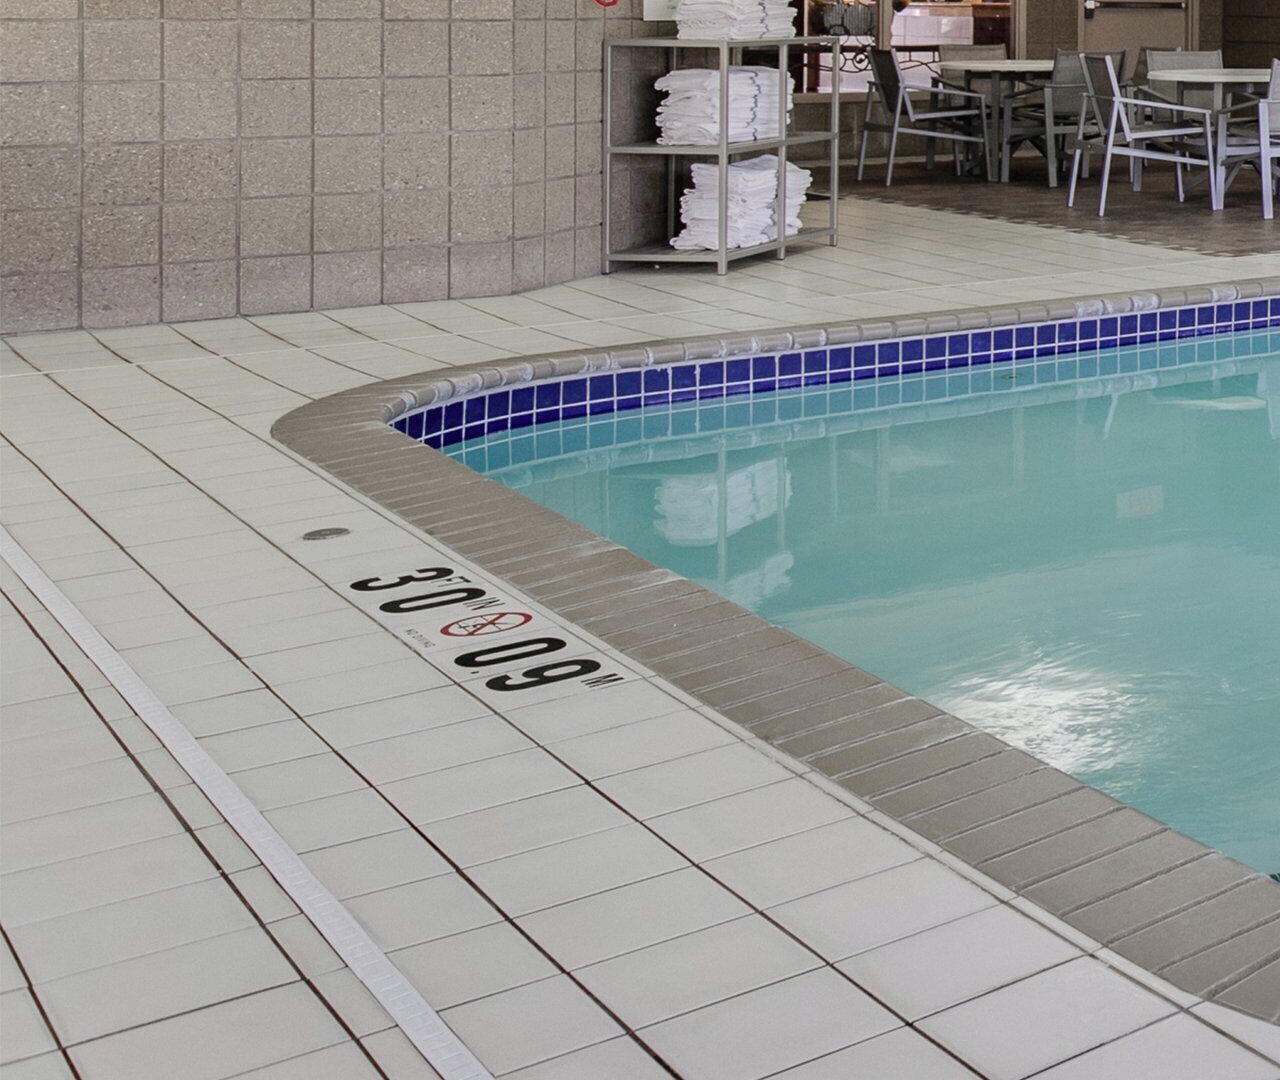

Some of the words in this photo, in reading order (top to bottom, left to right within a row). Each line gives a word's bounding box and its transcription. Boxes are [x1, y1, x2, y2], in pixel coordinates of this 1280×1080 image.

[350, 567, 454, 591] 3
[379, 587, 486, 613] 0
[462, 596, 505, 611] IN
[581, 673, 624, 688] M
